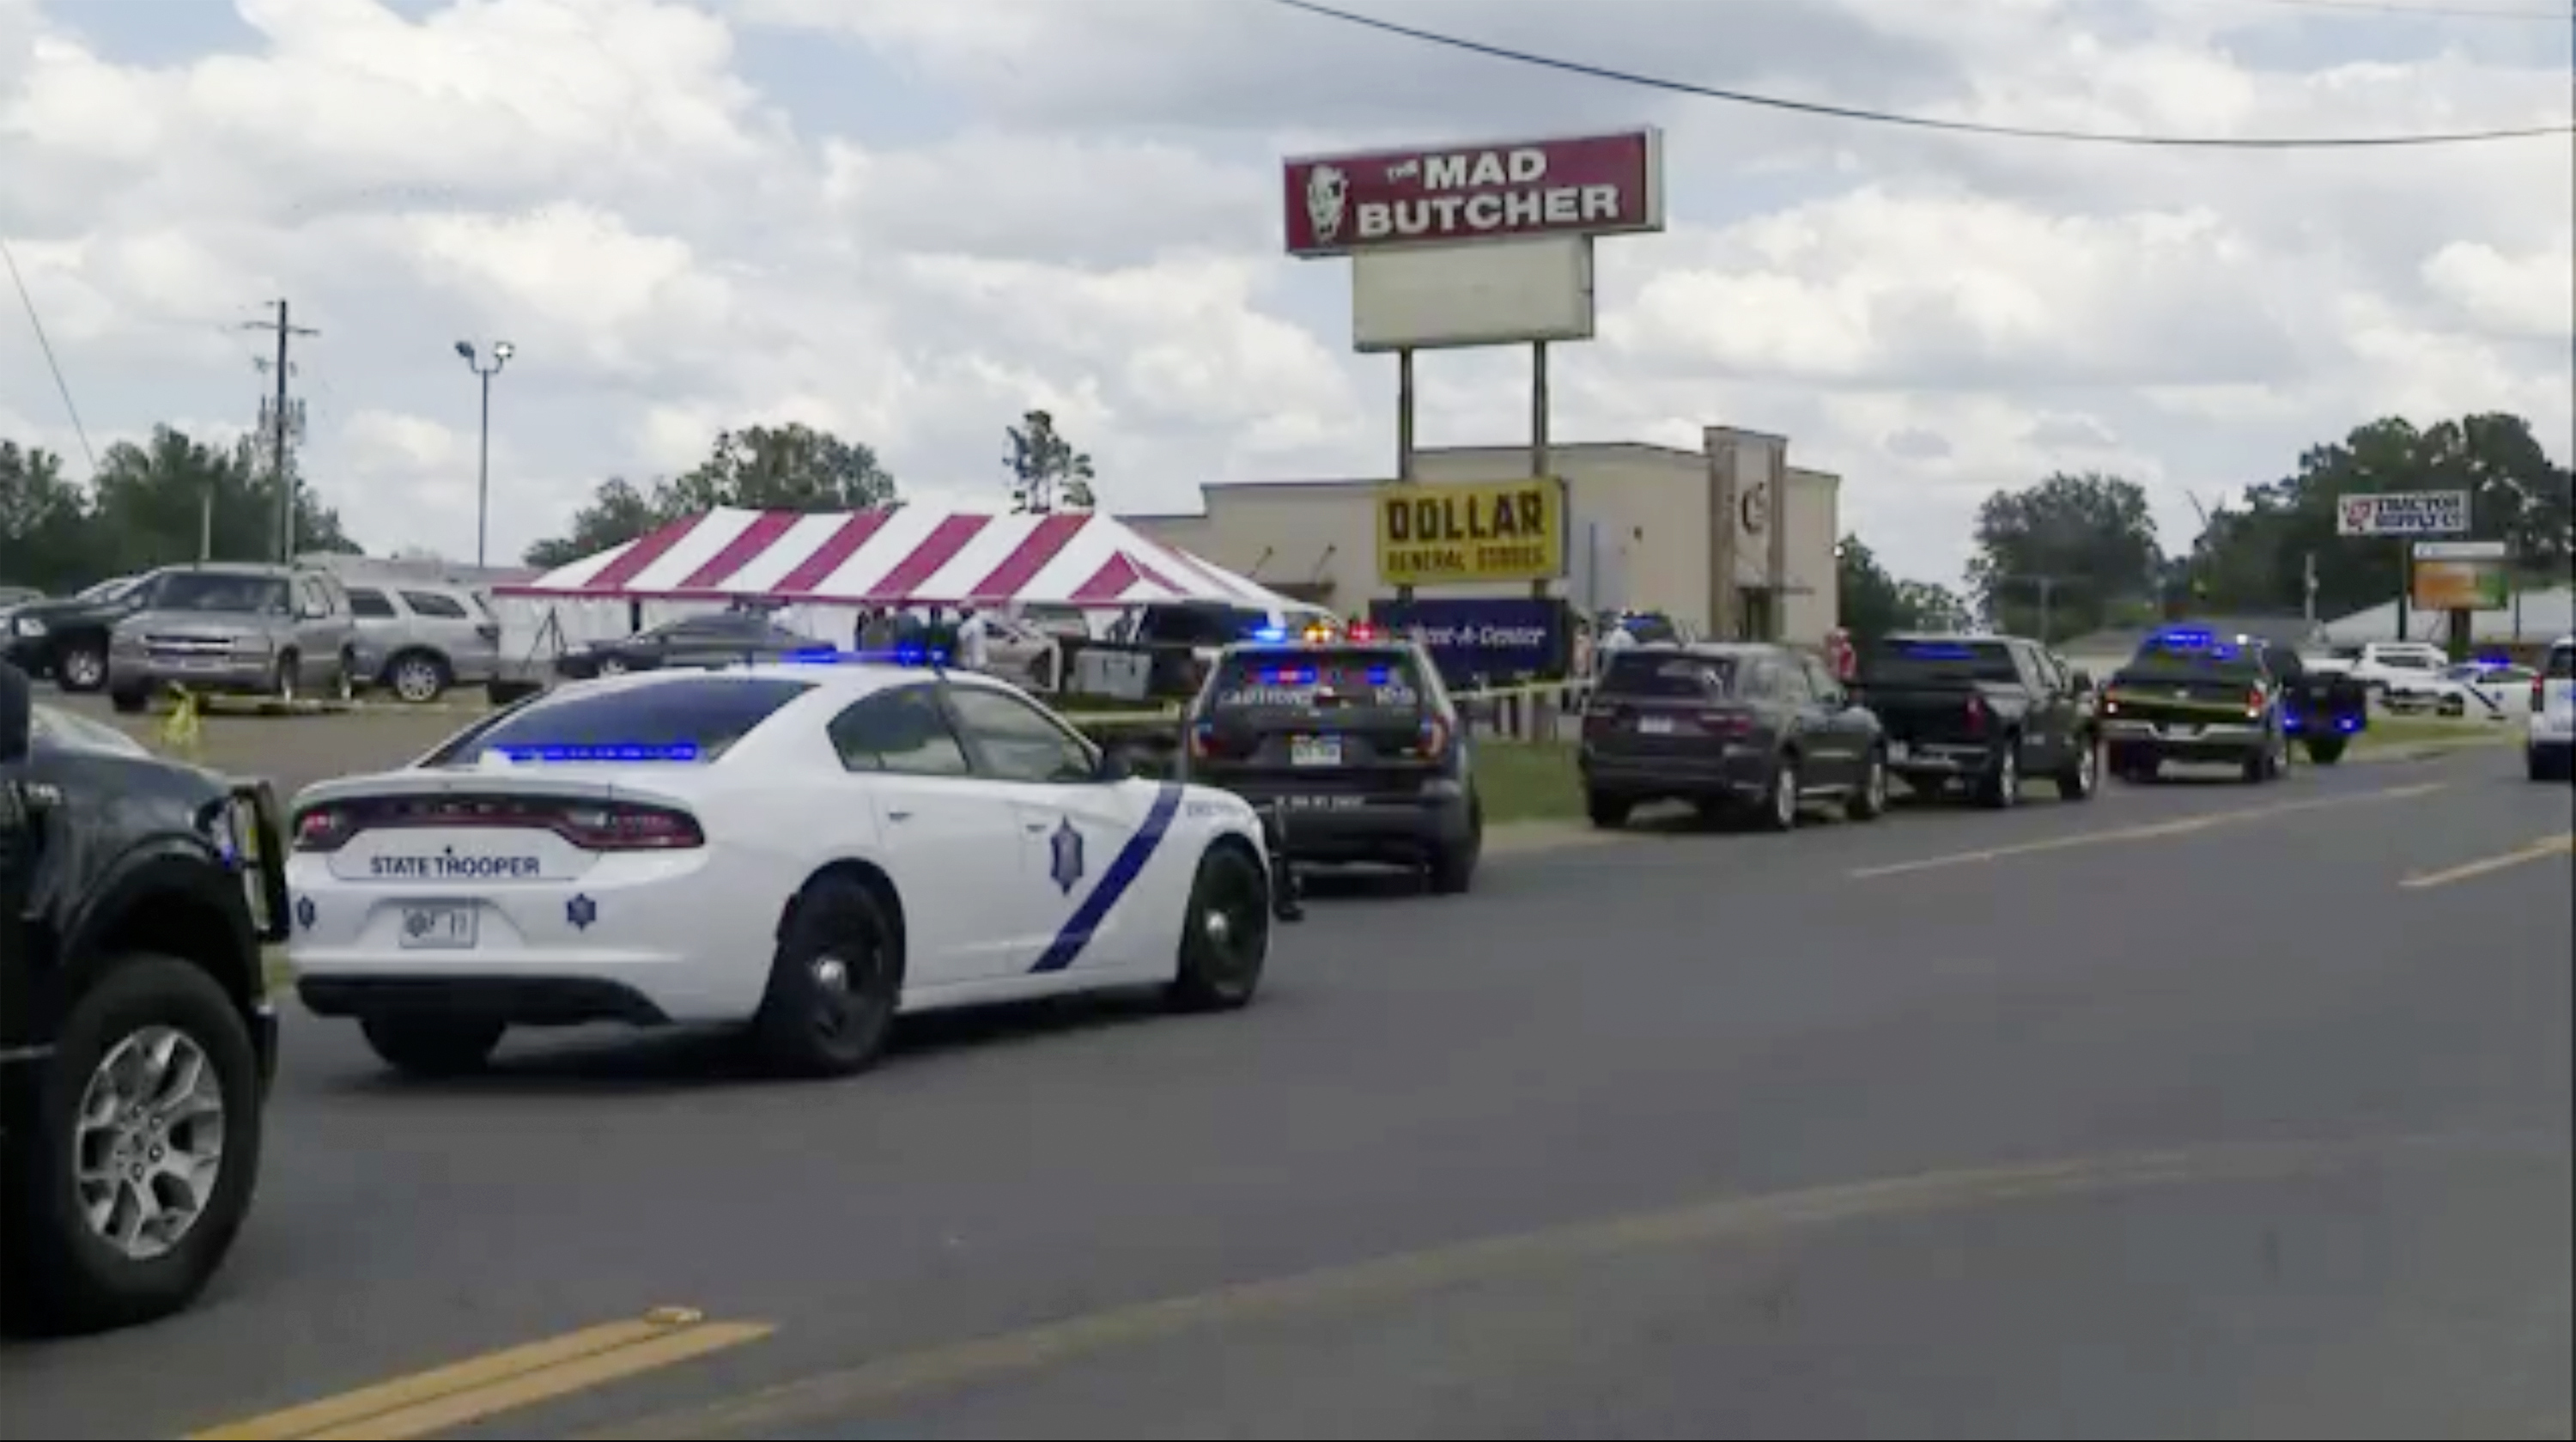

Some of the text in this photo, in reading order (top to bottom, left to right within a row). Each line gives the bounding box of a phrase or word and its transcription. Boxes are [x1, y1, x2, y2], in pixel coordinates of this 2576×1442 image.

[1423, 149, 1546, 191] MAD
[1357, 184, 1619, 237] BUTCHER
[1386, 490, 1545, 543] DOLLAR
[370, 855, 540, 875] STATE TROOPER
